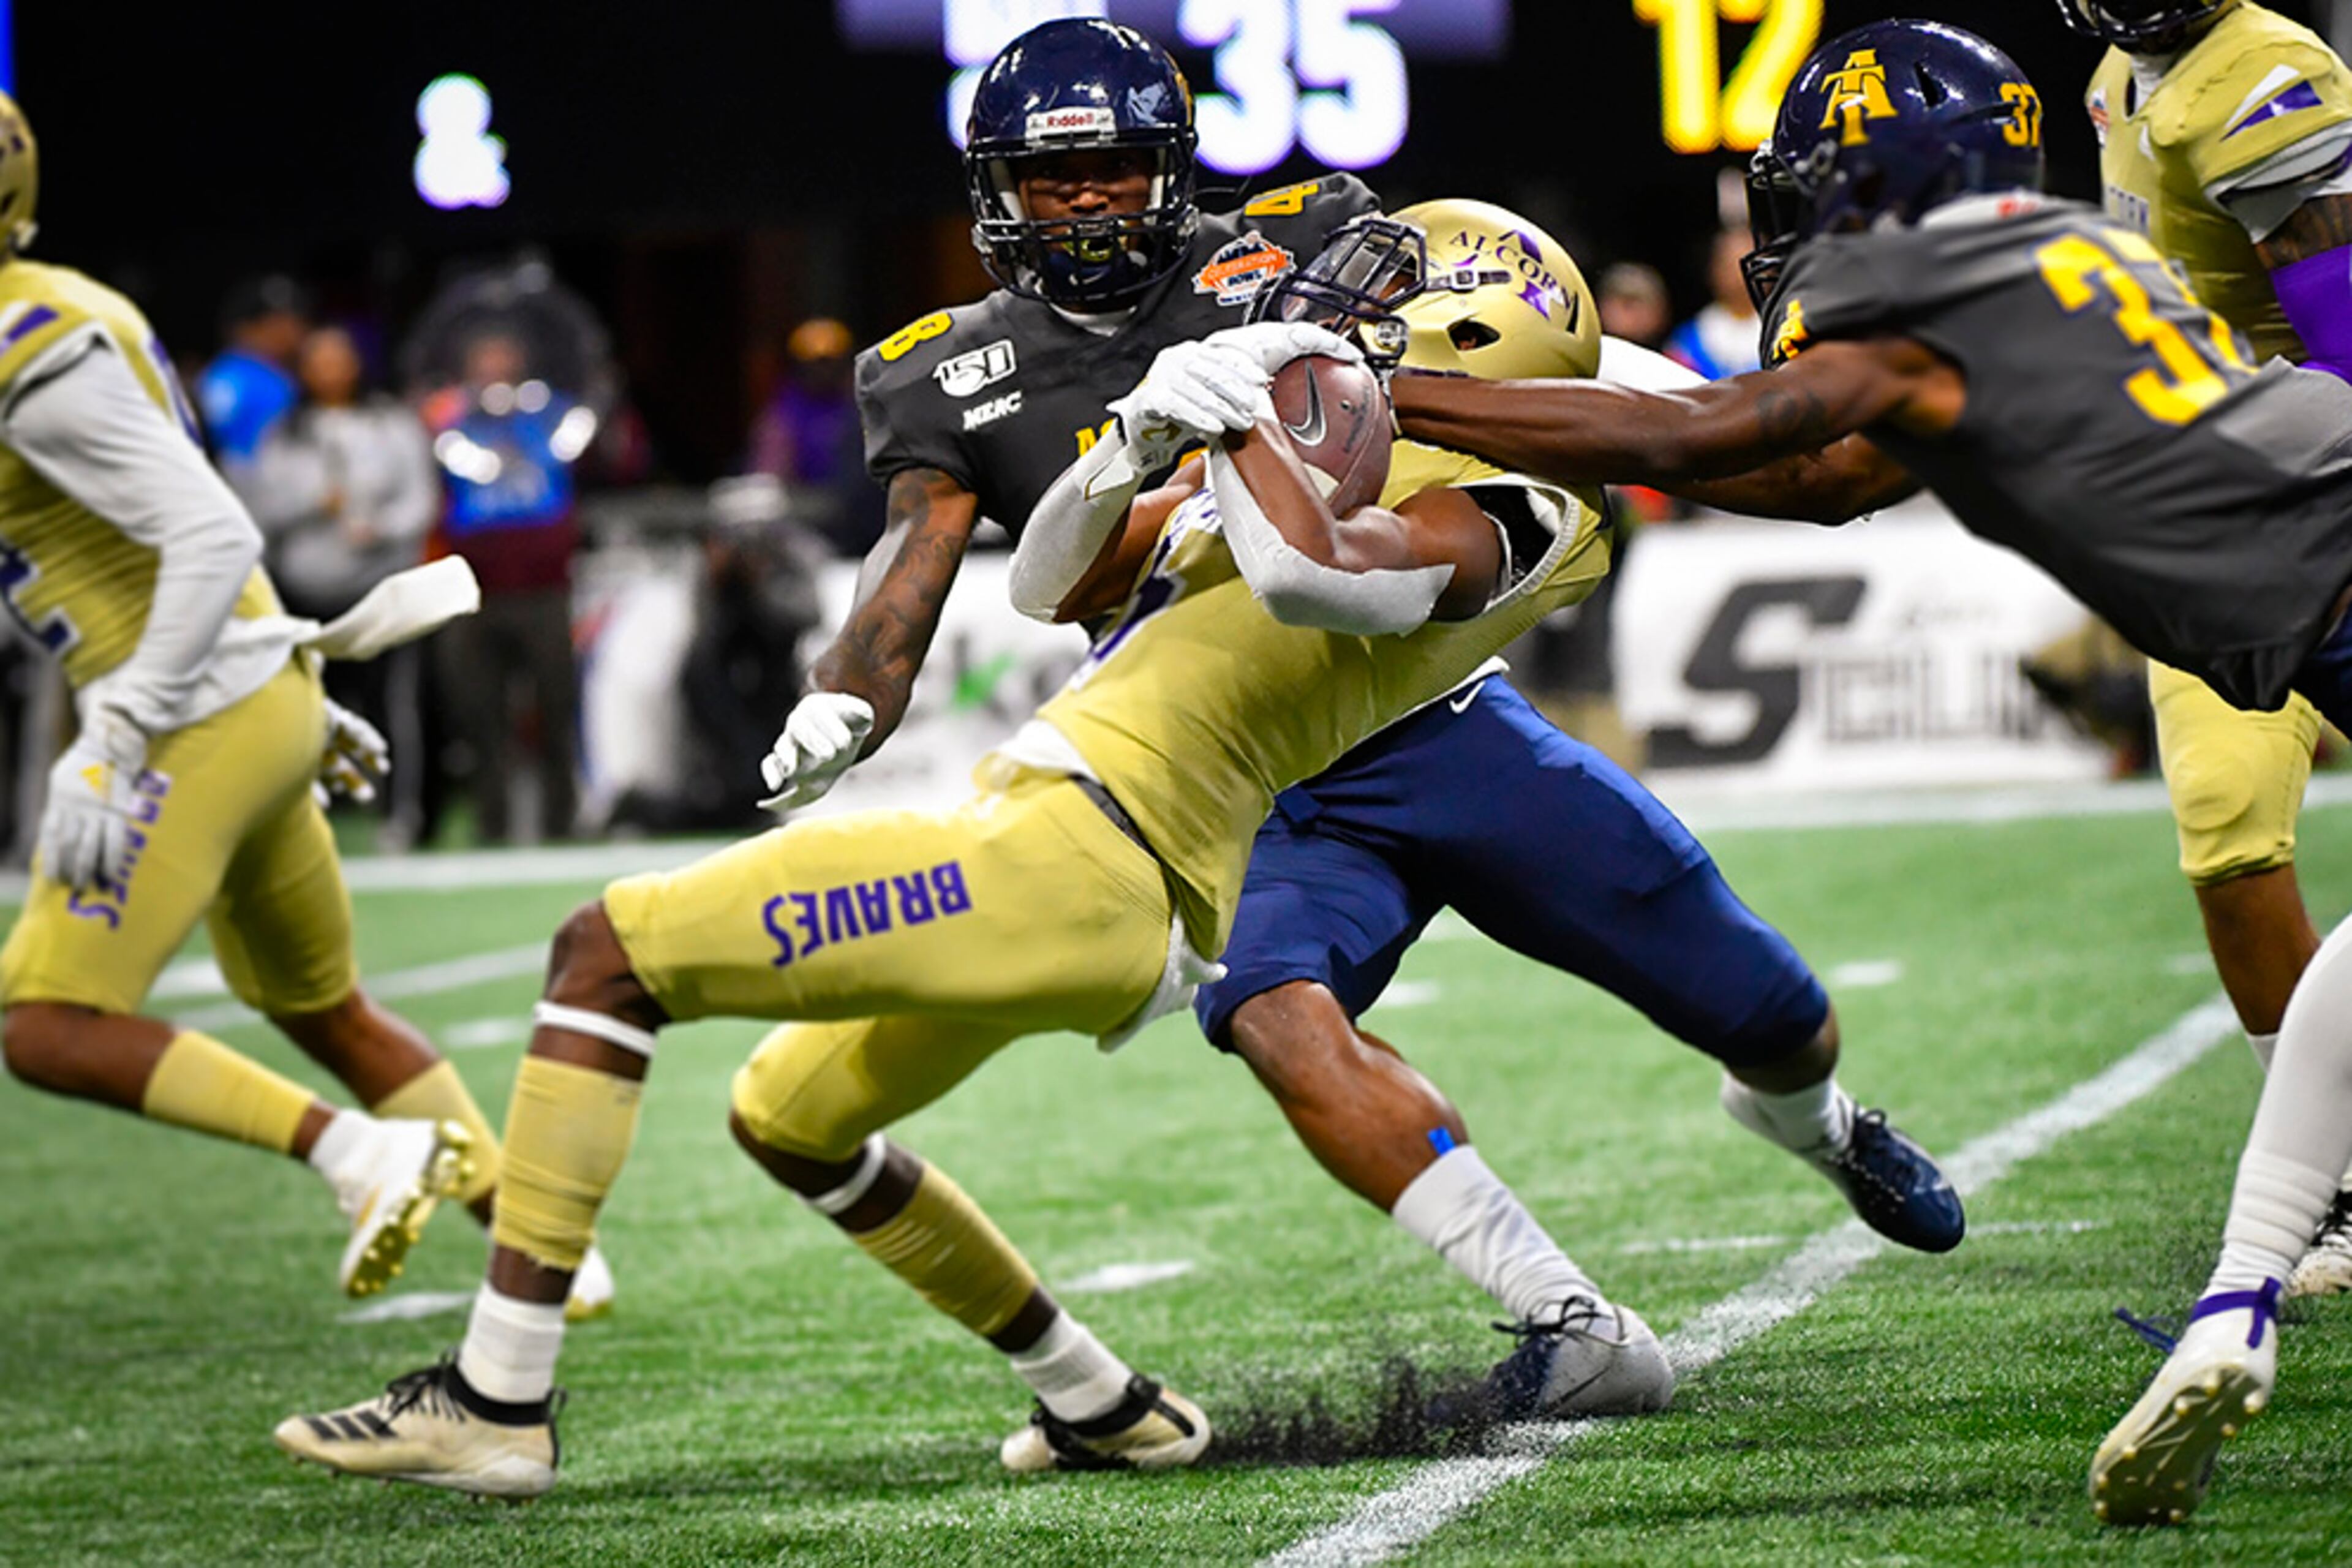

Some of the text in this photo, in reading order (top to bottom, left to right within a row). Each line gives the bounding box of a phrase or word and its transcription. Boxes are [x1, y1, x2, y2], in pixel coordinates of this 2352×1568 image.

[1177, 0, 1410, 175] 35
[1632, 0, 1825, 153] 12
[1047, 113, 1095, 128] Riddell
[1999, 81, 2042, 148] 37
[1245, 178, 1319, 216] 4
[878, 311, 953, 361] 8
[933, 339, 1017, 397] 150
[962, 390, 1023, 431] MEAC
[67, 768, 172, 931] BRS
[761, 860, 973, 969] BRAVES
